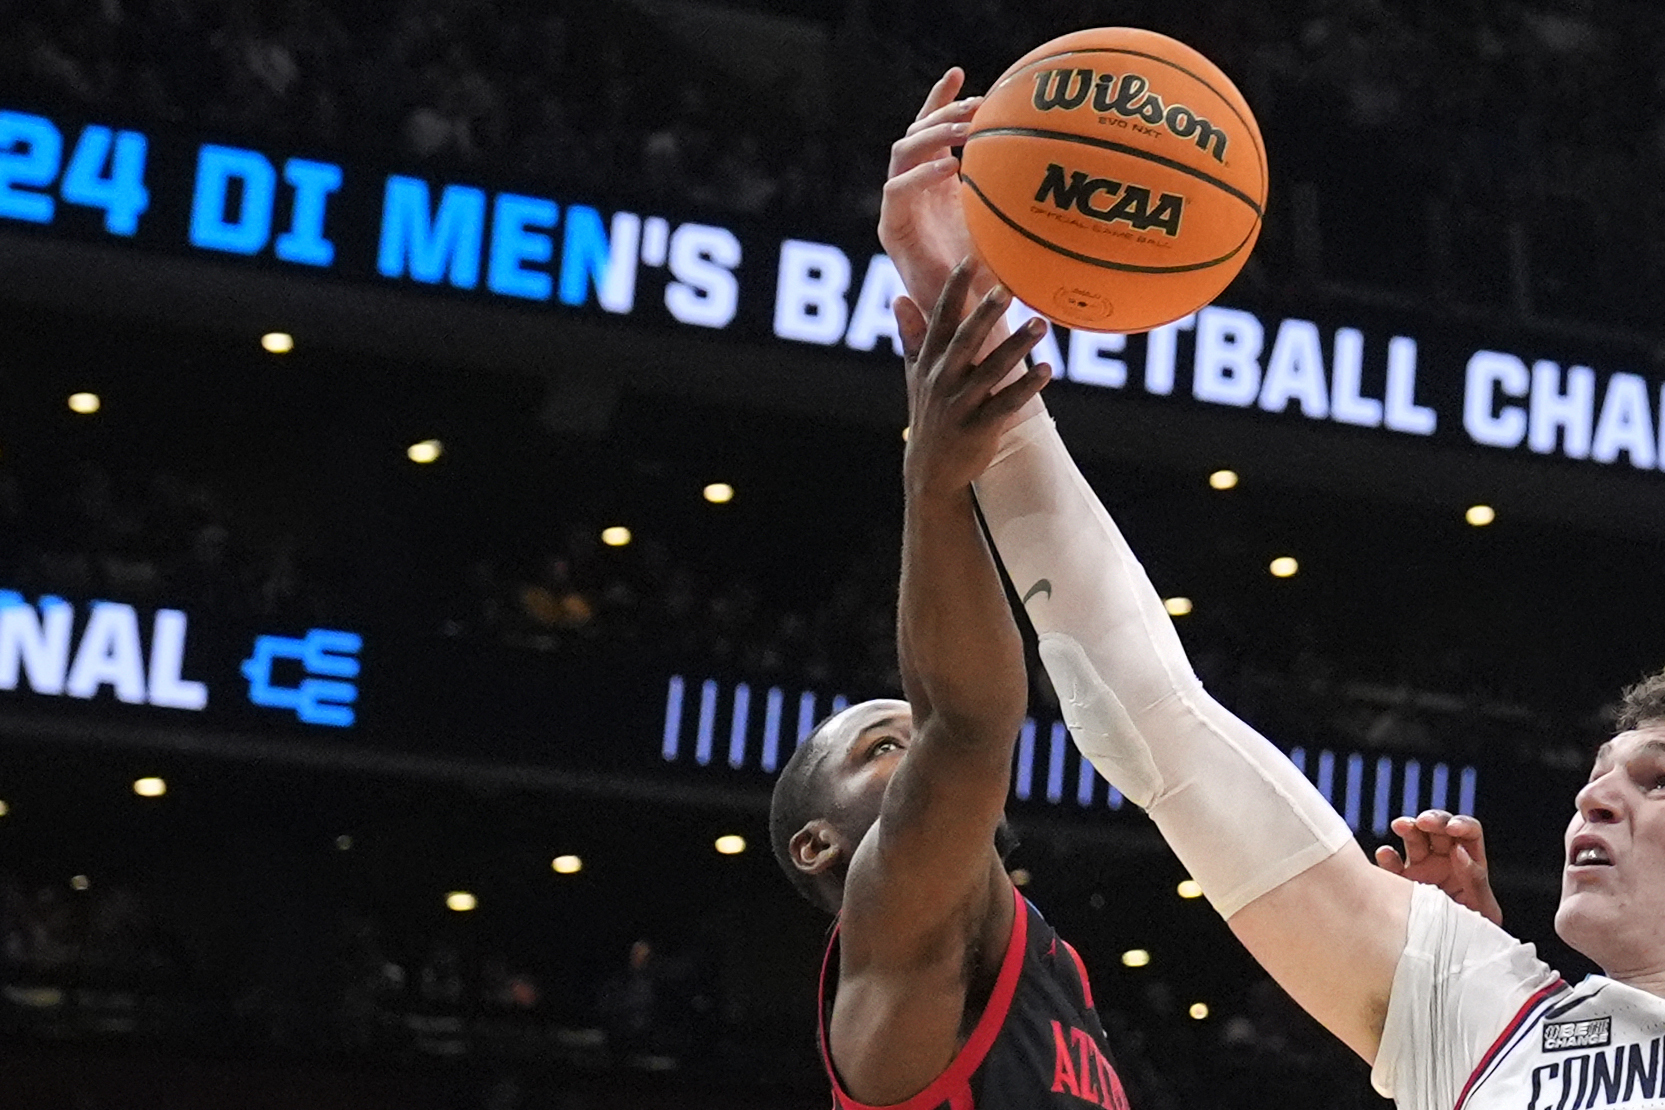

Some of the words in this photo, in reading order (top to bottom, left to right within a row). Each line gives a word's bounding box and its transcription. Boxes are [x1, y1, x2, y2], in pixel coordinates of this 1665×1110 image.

[1033, 68, 1229, 164] Wilson
[1098, 117, 1129, 129] EVO
[1132, 124, 1162, 139] NXT
[1034, 163, 1185, 239] NCAA
[0, 110, 149, 236] 24
[189, 143, 343, 268] DI
[377, 175, 742, 329] MEN'S
[773, 238, 1438, 436] BAETBALL
[0, 588, 208, 711] NAL
[1544, 1032, 1609, 1050] CHANGE
[1559, 1022, 1590, 1039] BE
